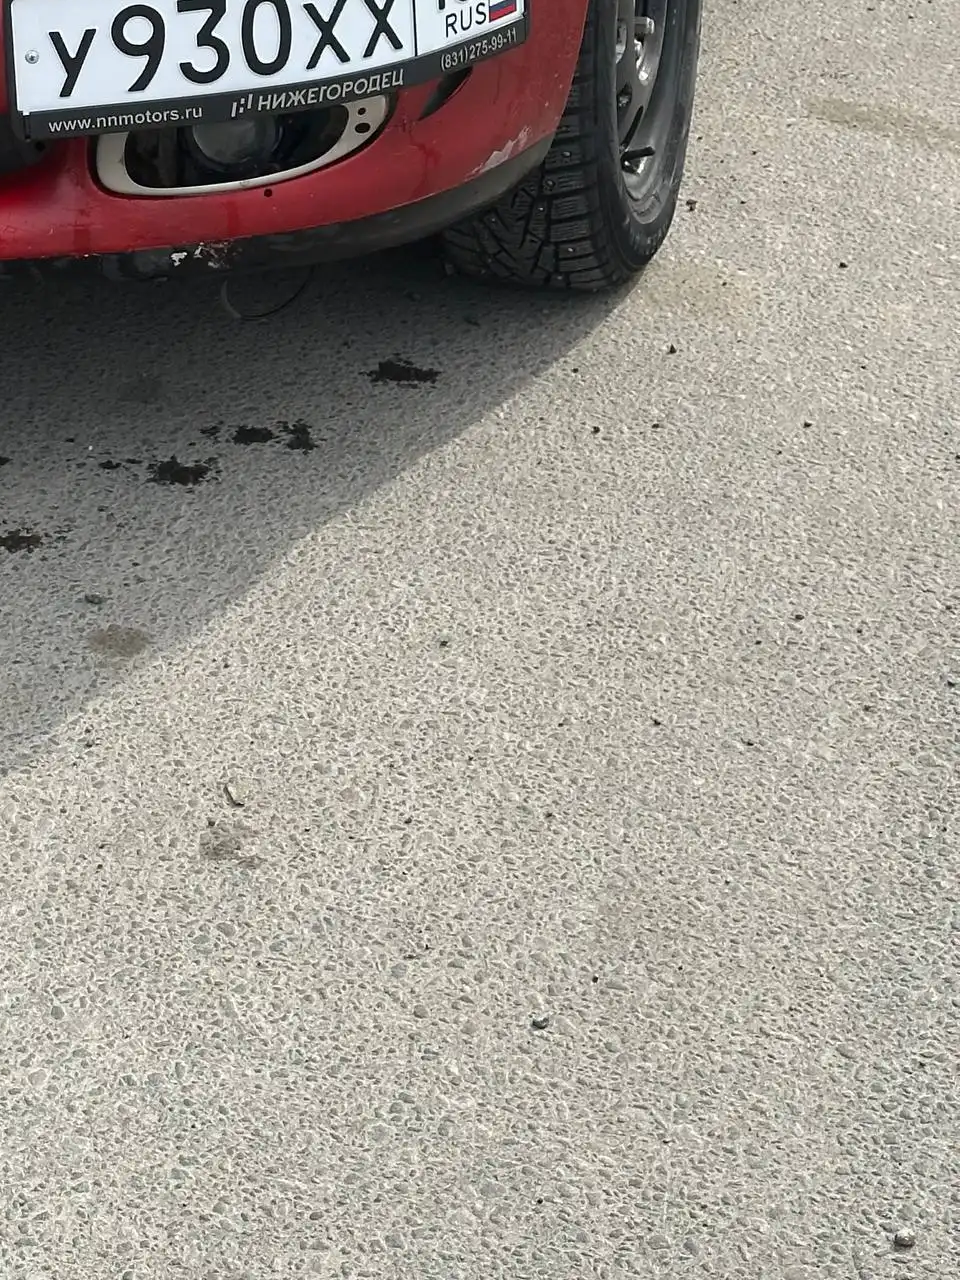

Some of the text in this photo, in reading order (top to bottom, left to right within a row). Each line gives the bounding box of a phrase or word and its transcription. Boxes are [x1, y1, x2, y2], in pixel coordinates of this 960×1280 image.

[445, 1, 487, 38] RUS
[257, 68, 404, 112] НИЖЕГОРОДЕЦ
[48, 106, 203, 133] www.nnmotors.ru
